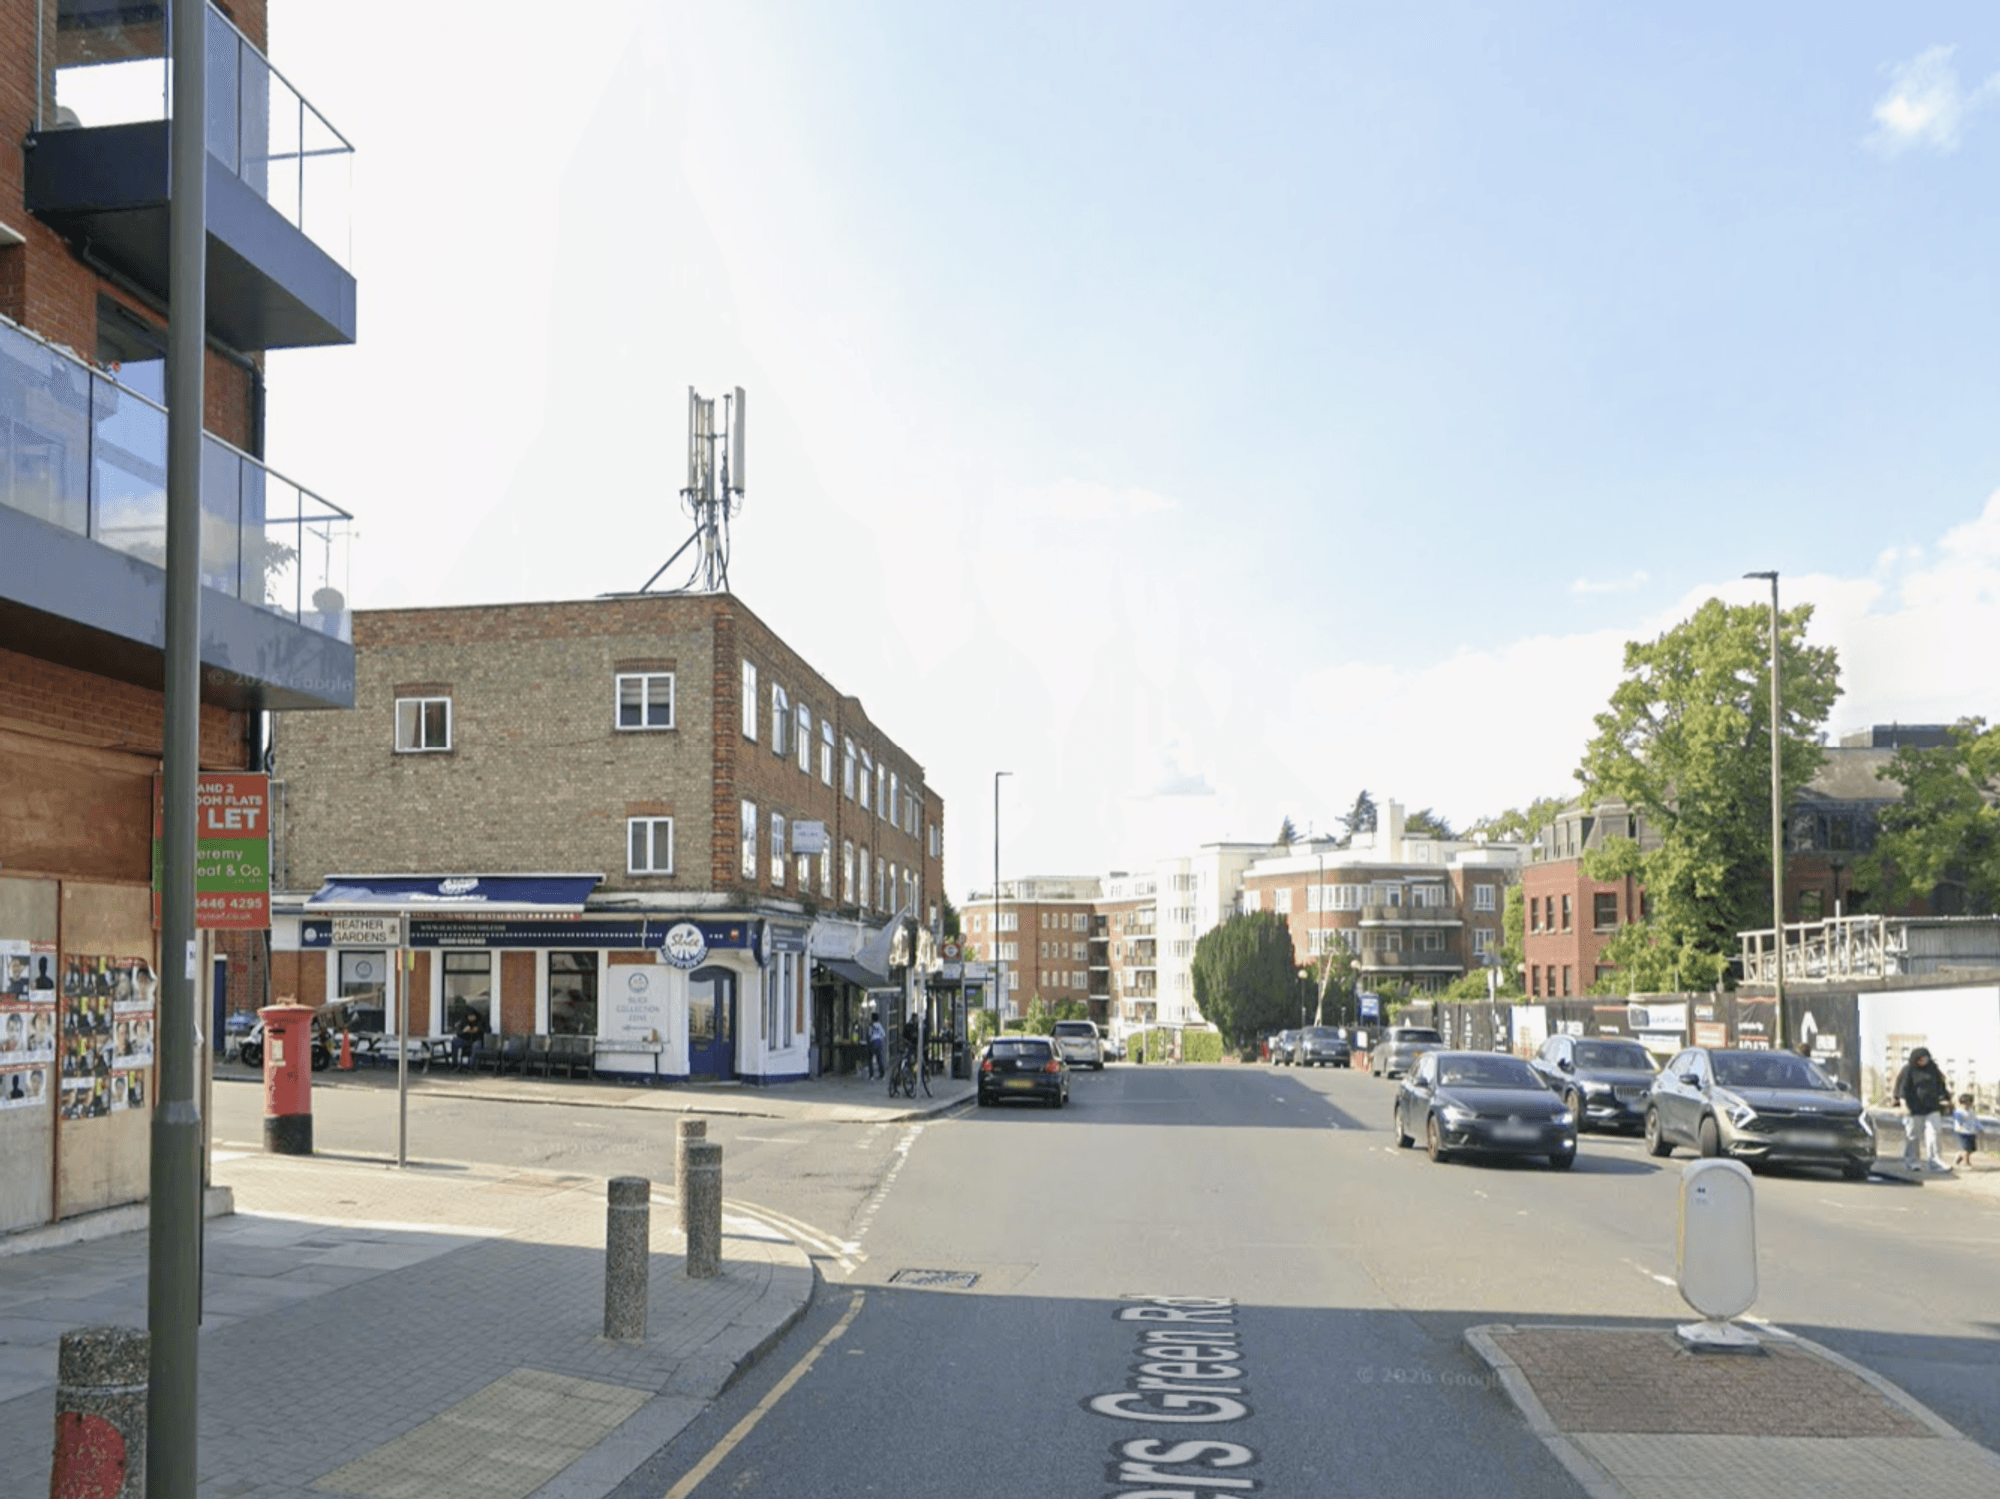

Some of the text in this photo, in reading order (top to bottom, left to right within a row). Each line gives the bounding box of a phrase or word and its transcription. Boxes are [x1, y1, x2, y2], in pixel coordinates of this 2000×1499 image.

[196, 783, 236, 794] AND 2
[224, 795, 263, 806] FLATS
[207, 808, 261, 829] LET
[196, 850, 244, 862] eremy
[196, 863, 264, 877] eaf & Co.
[195, 898, 227, 909] 446
[334, 919, 384, 930] HEATHER
[333, 931, 387, 943] GARDENS
